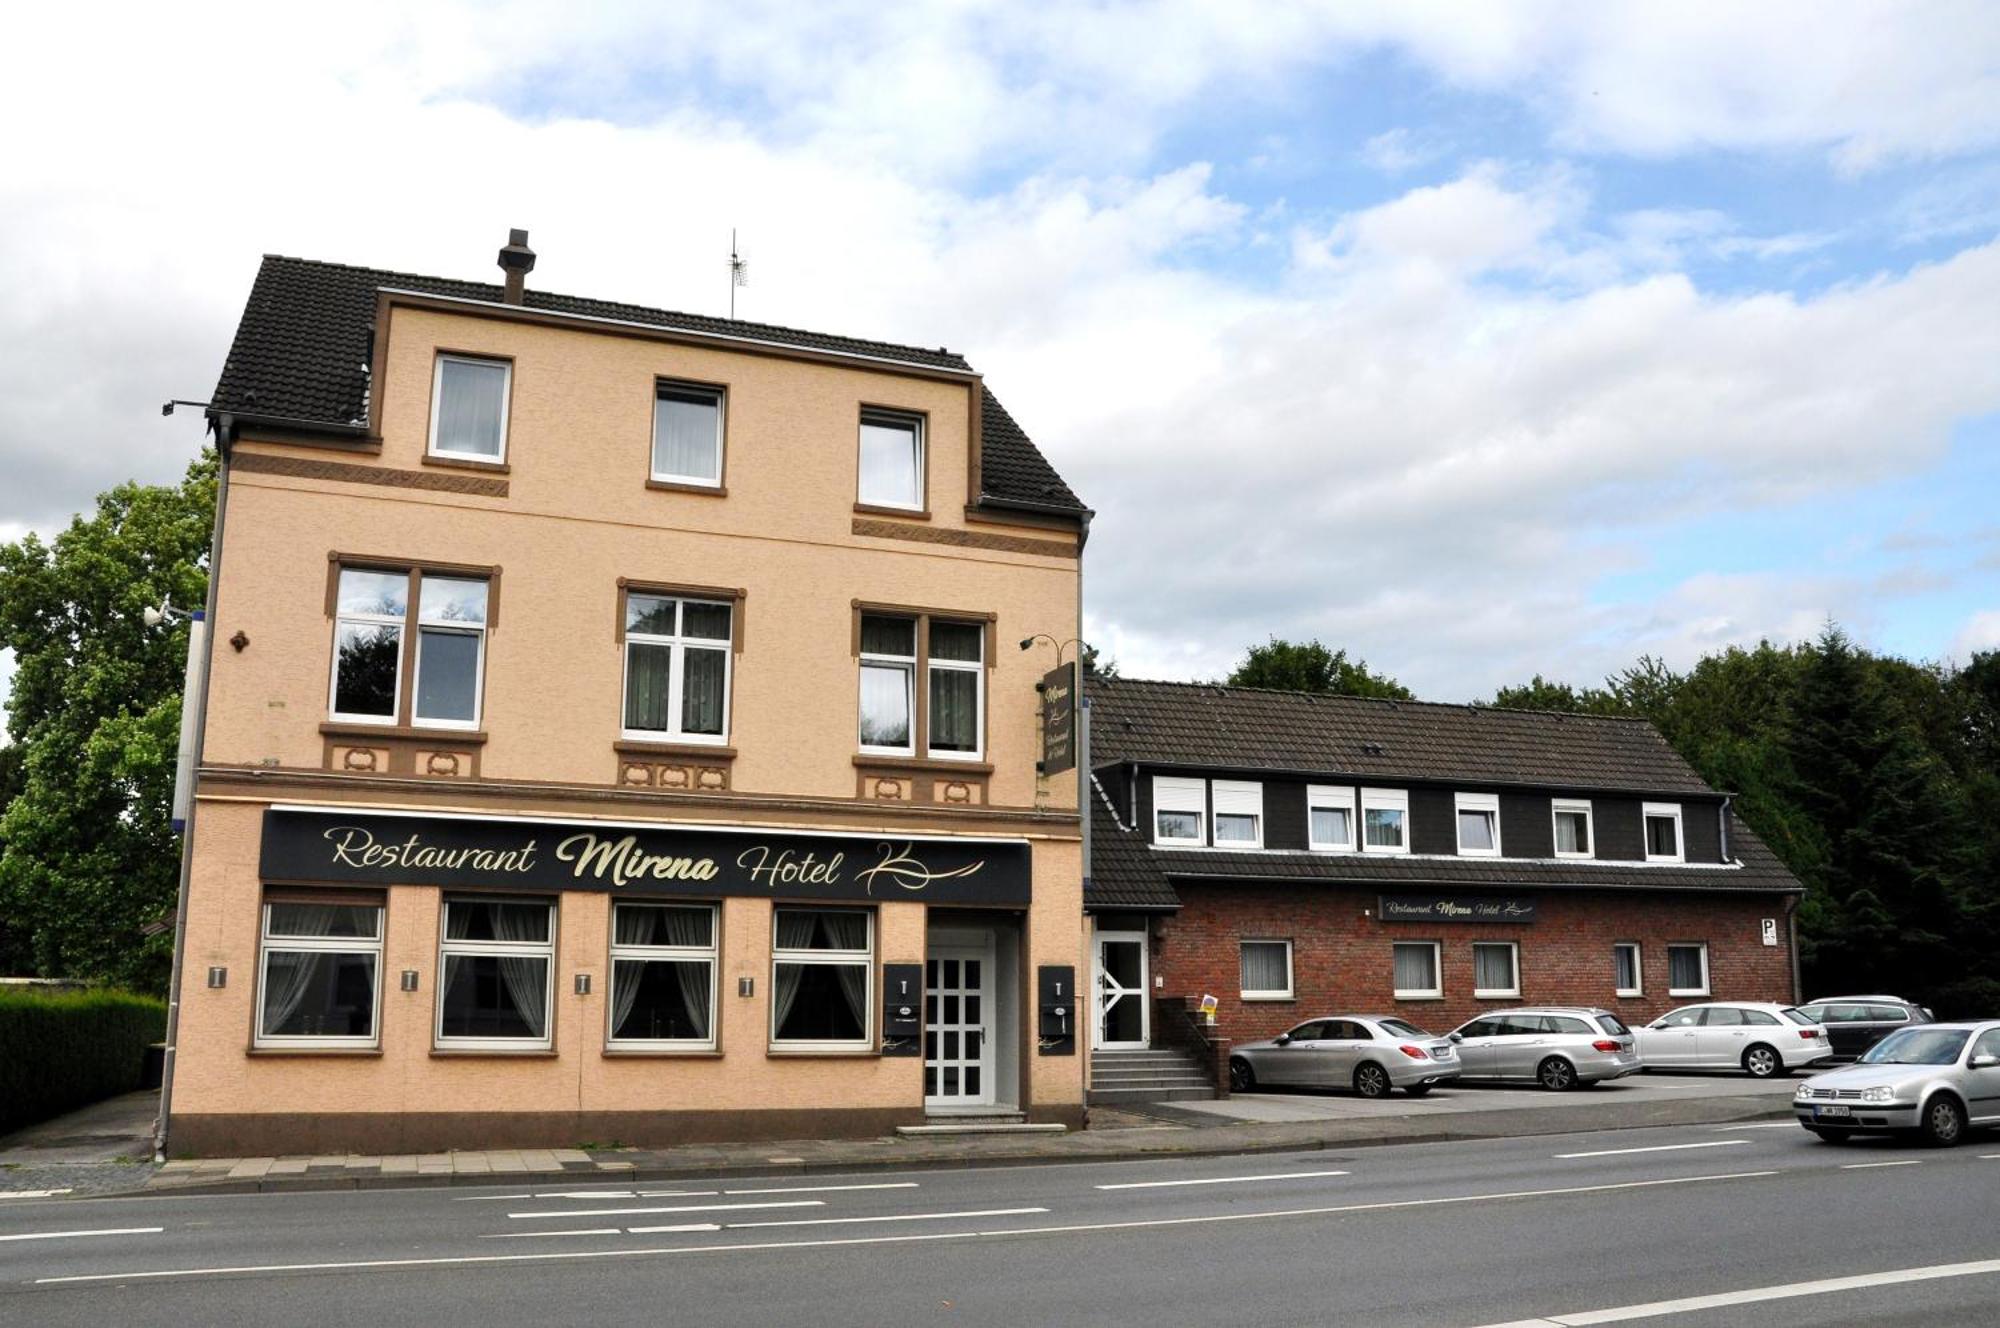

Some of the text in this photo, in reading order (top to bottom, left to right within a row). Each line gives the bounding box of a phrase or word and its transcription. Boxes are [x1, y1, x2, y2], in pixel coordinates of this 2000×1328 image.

[323, 826, 845, 886] Restaurant Mirena Hotel
[1386, 901, 1500, 916] Restaurant Mirena Hotel
[1764, 920, 1773, 934] P
